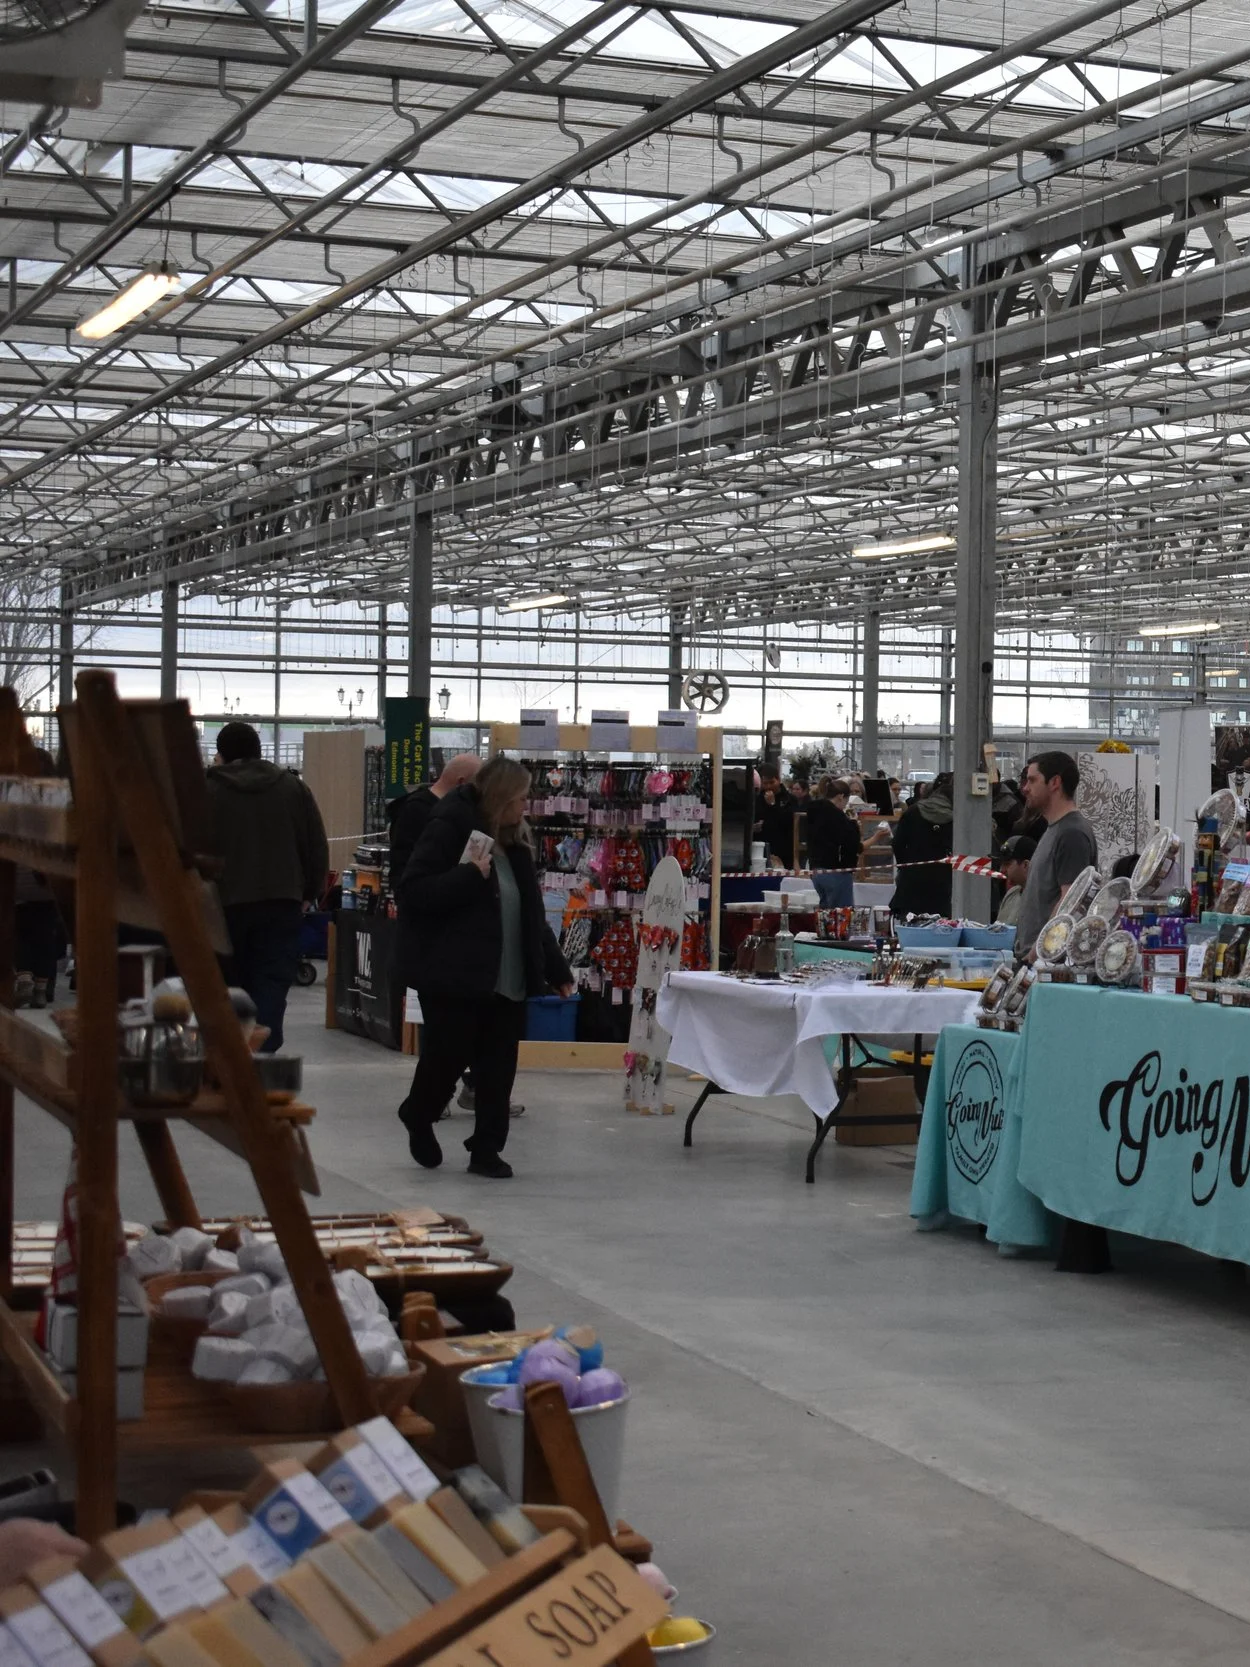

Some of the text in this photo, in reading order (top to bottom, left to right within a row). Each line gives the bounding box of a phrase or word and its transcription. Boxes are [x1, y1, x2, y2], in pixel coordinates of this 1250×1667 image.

[414, 722, 423, 741] The
[1099, 1050, 1224, 1186] Going
[524, 1569, 633, 1659] SOAP
